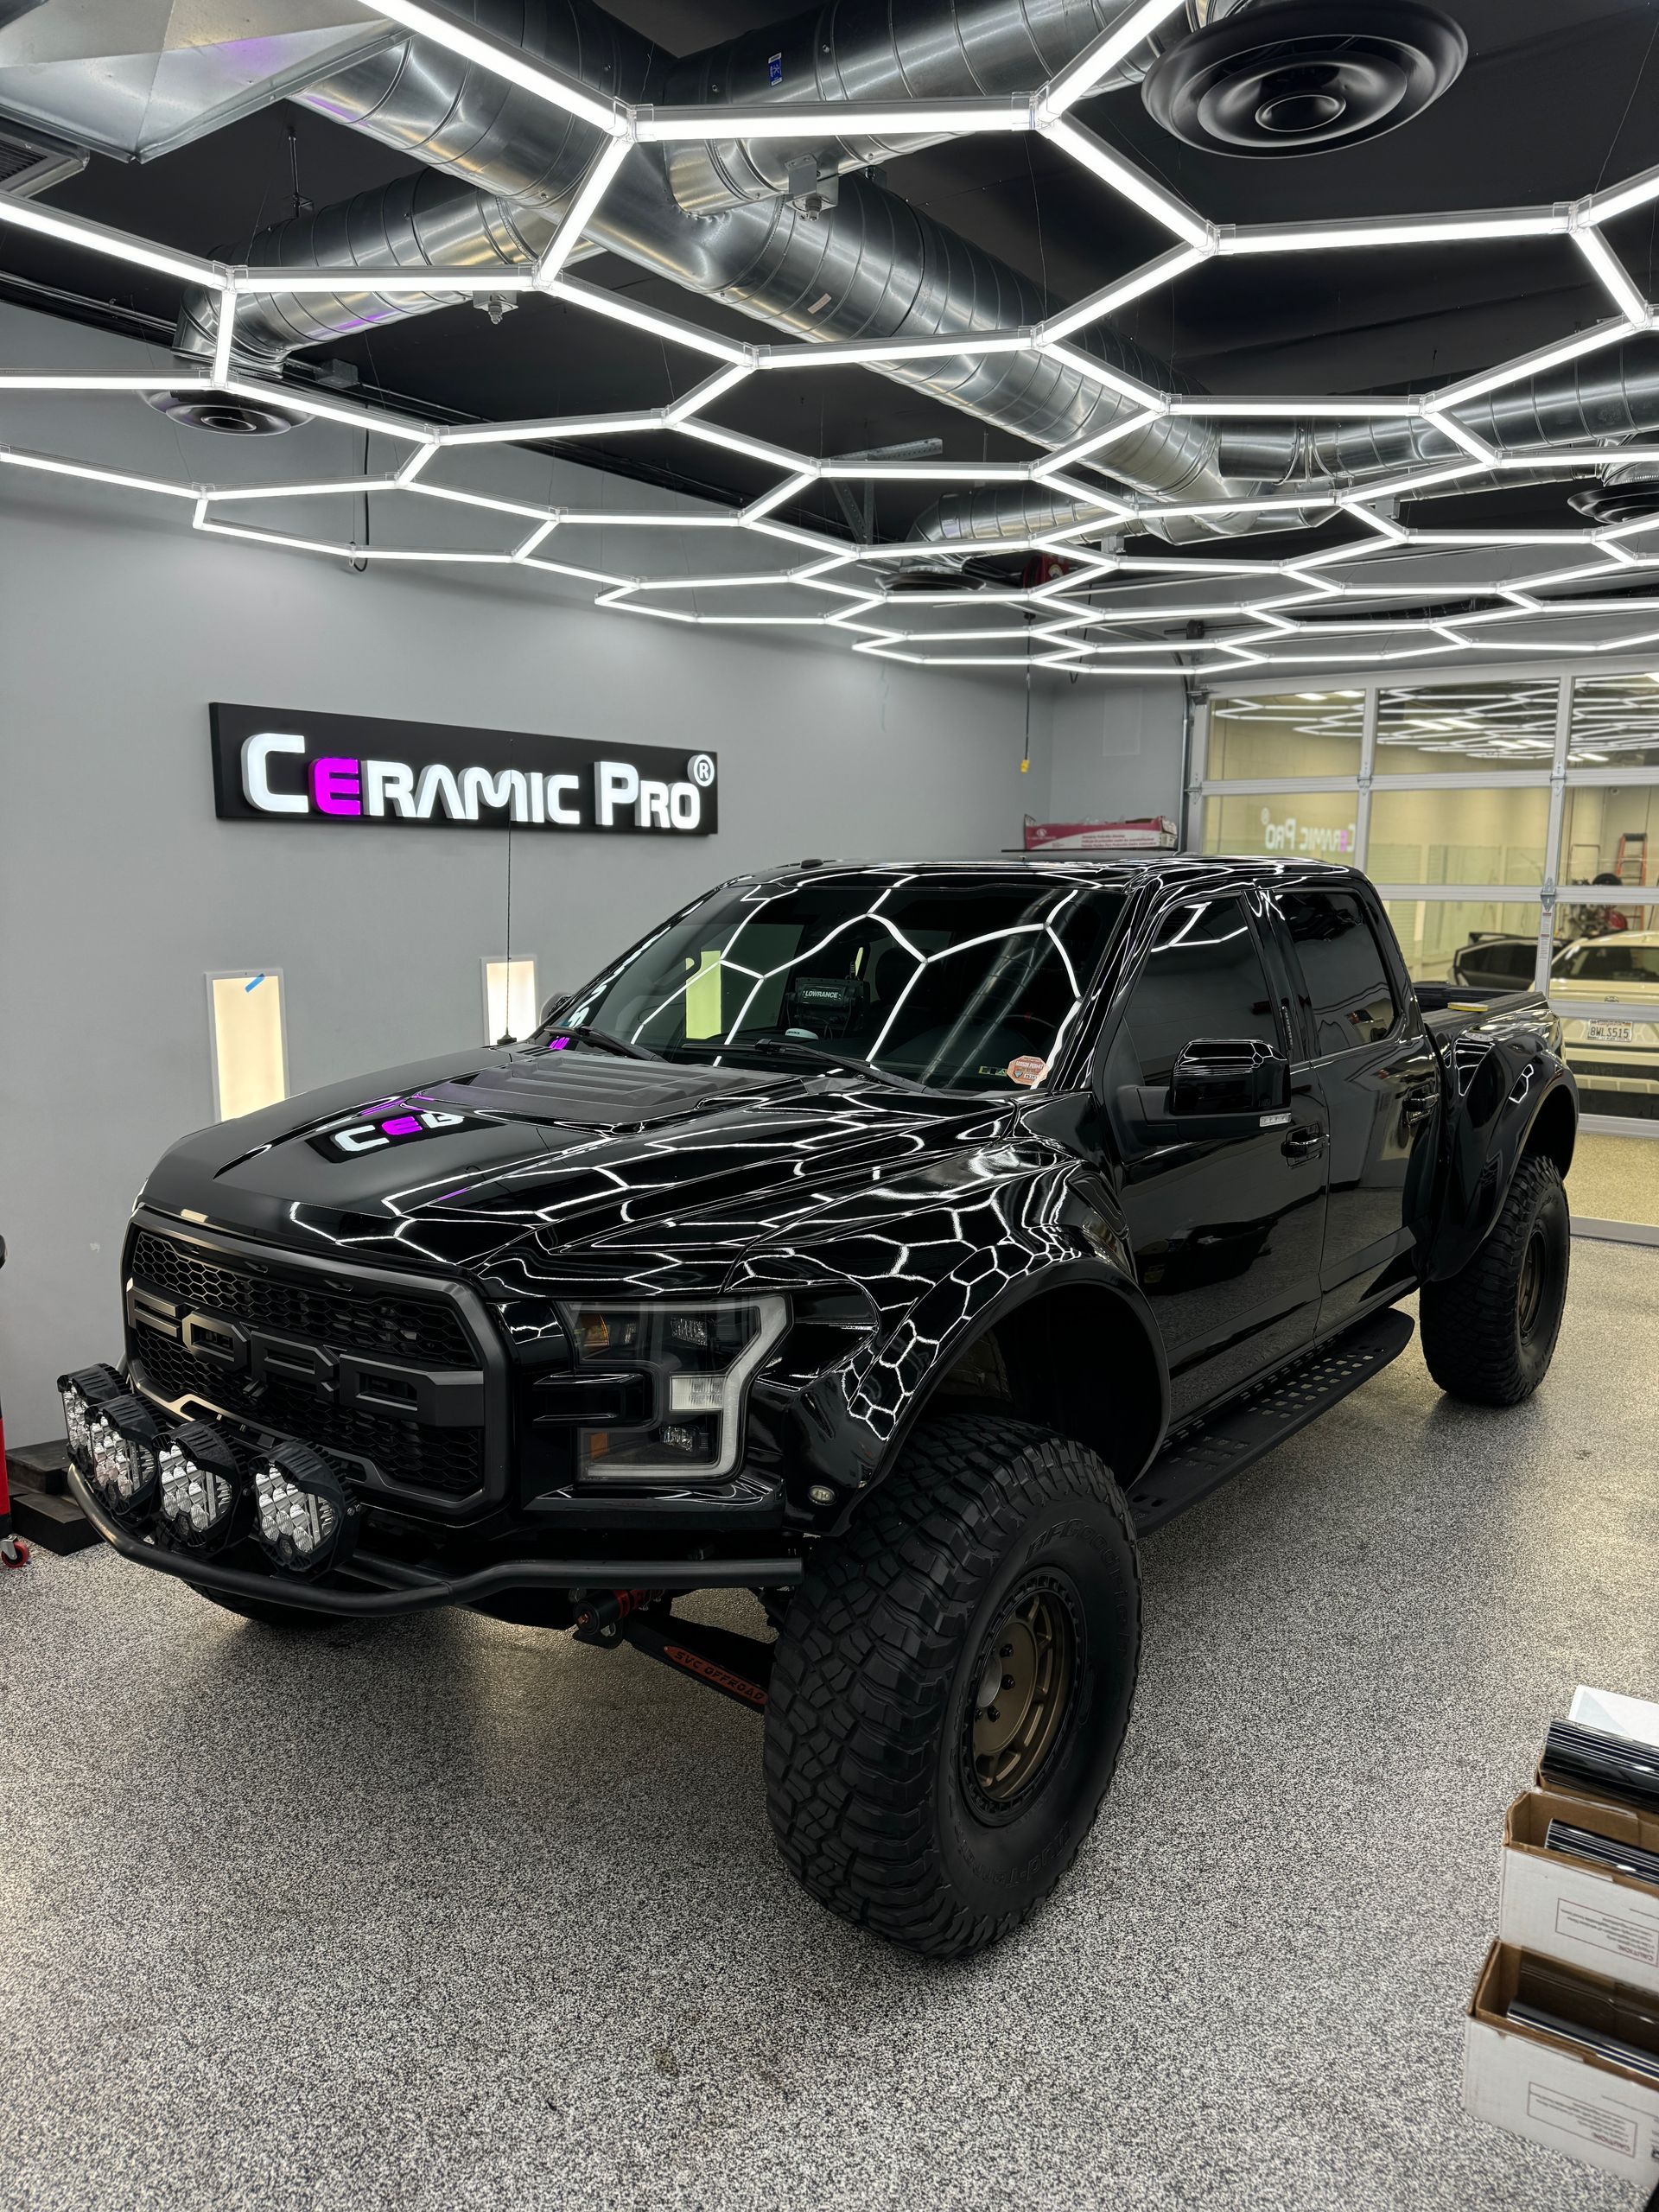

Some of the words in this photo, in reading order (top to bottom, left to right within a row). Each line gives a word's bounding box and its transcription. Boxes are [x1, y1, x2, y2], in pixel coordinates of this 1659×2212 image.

[241, 732, 581, 824] CERAMIC
[804, 990, 838, 999] LOWRANCE
[1590, 1027, 1629, 1039] 8WLS515
[127, 1281, 458, 1427] FORD
[675, 1650, 702, 1669] SVC
[703, 1665, 765, 1700] OFFROAD
